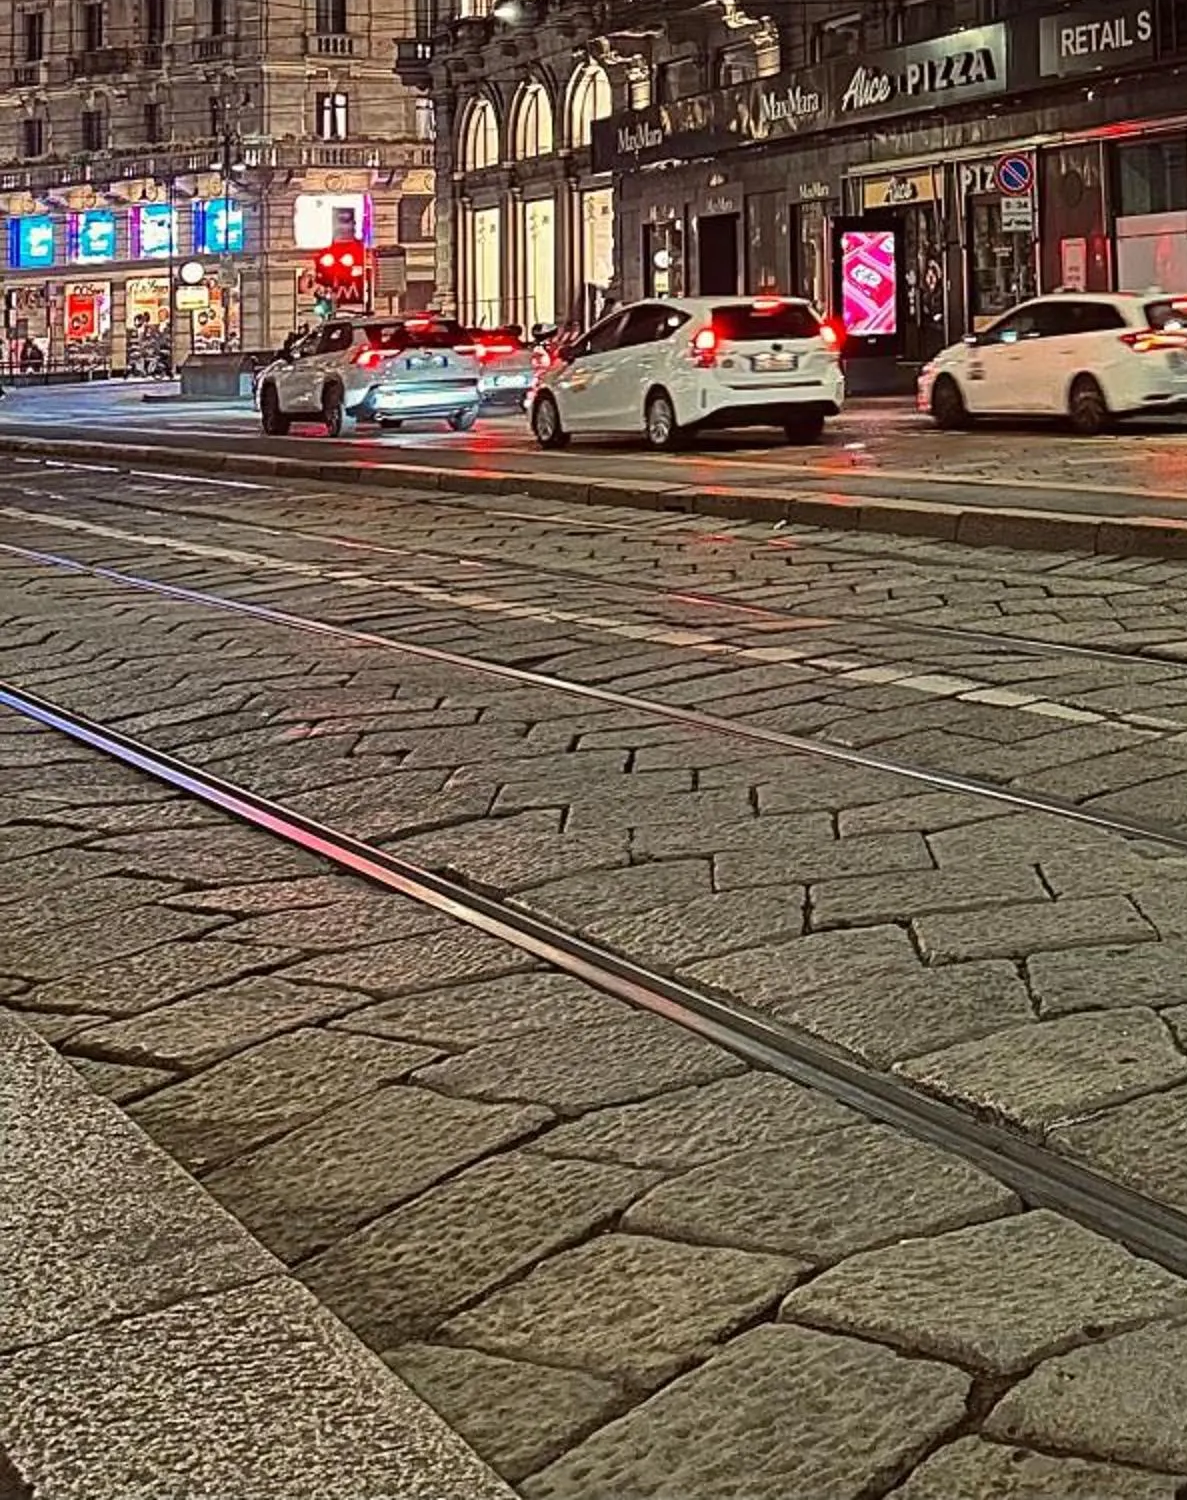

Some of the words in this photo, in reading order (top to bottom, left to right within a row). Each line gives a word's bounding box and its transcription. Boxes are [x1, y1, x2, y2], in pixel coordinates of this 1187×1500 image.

[1061, 17, 1133, 56] RETAIL
[1137, 10, 1151, 41] S
[841, 65, 891, 111] Alice
[907, 48, 996, 95] PIZZA
